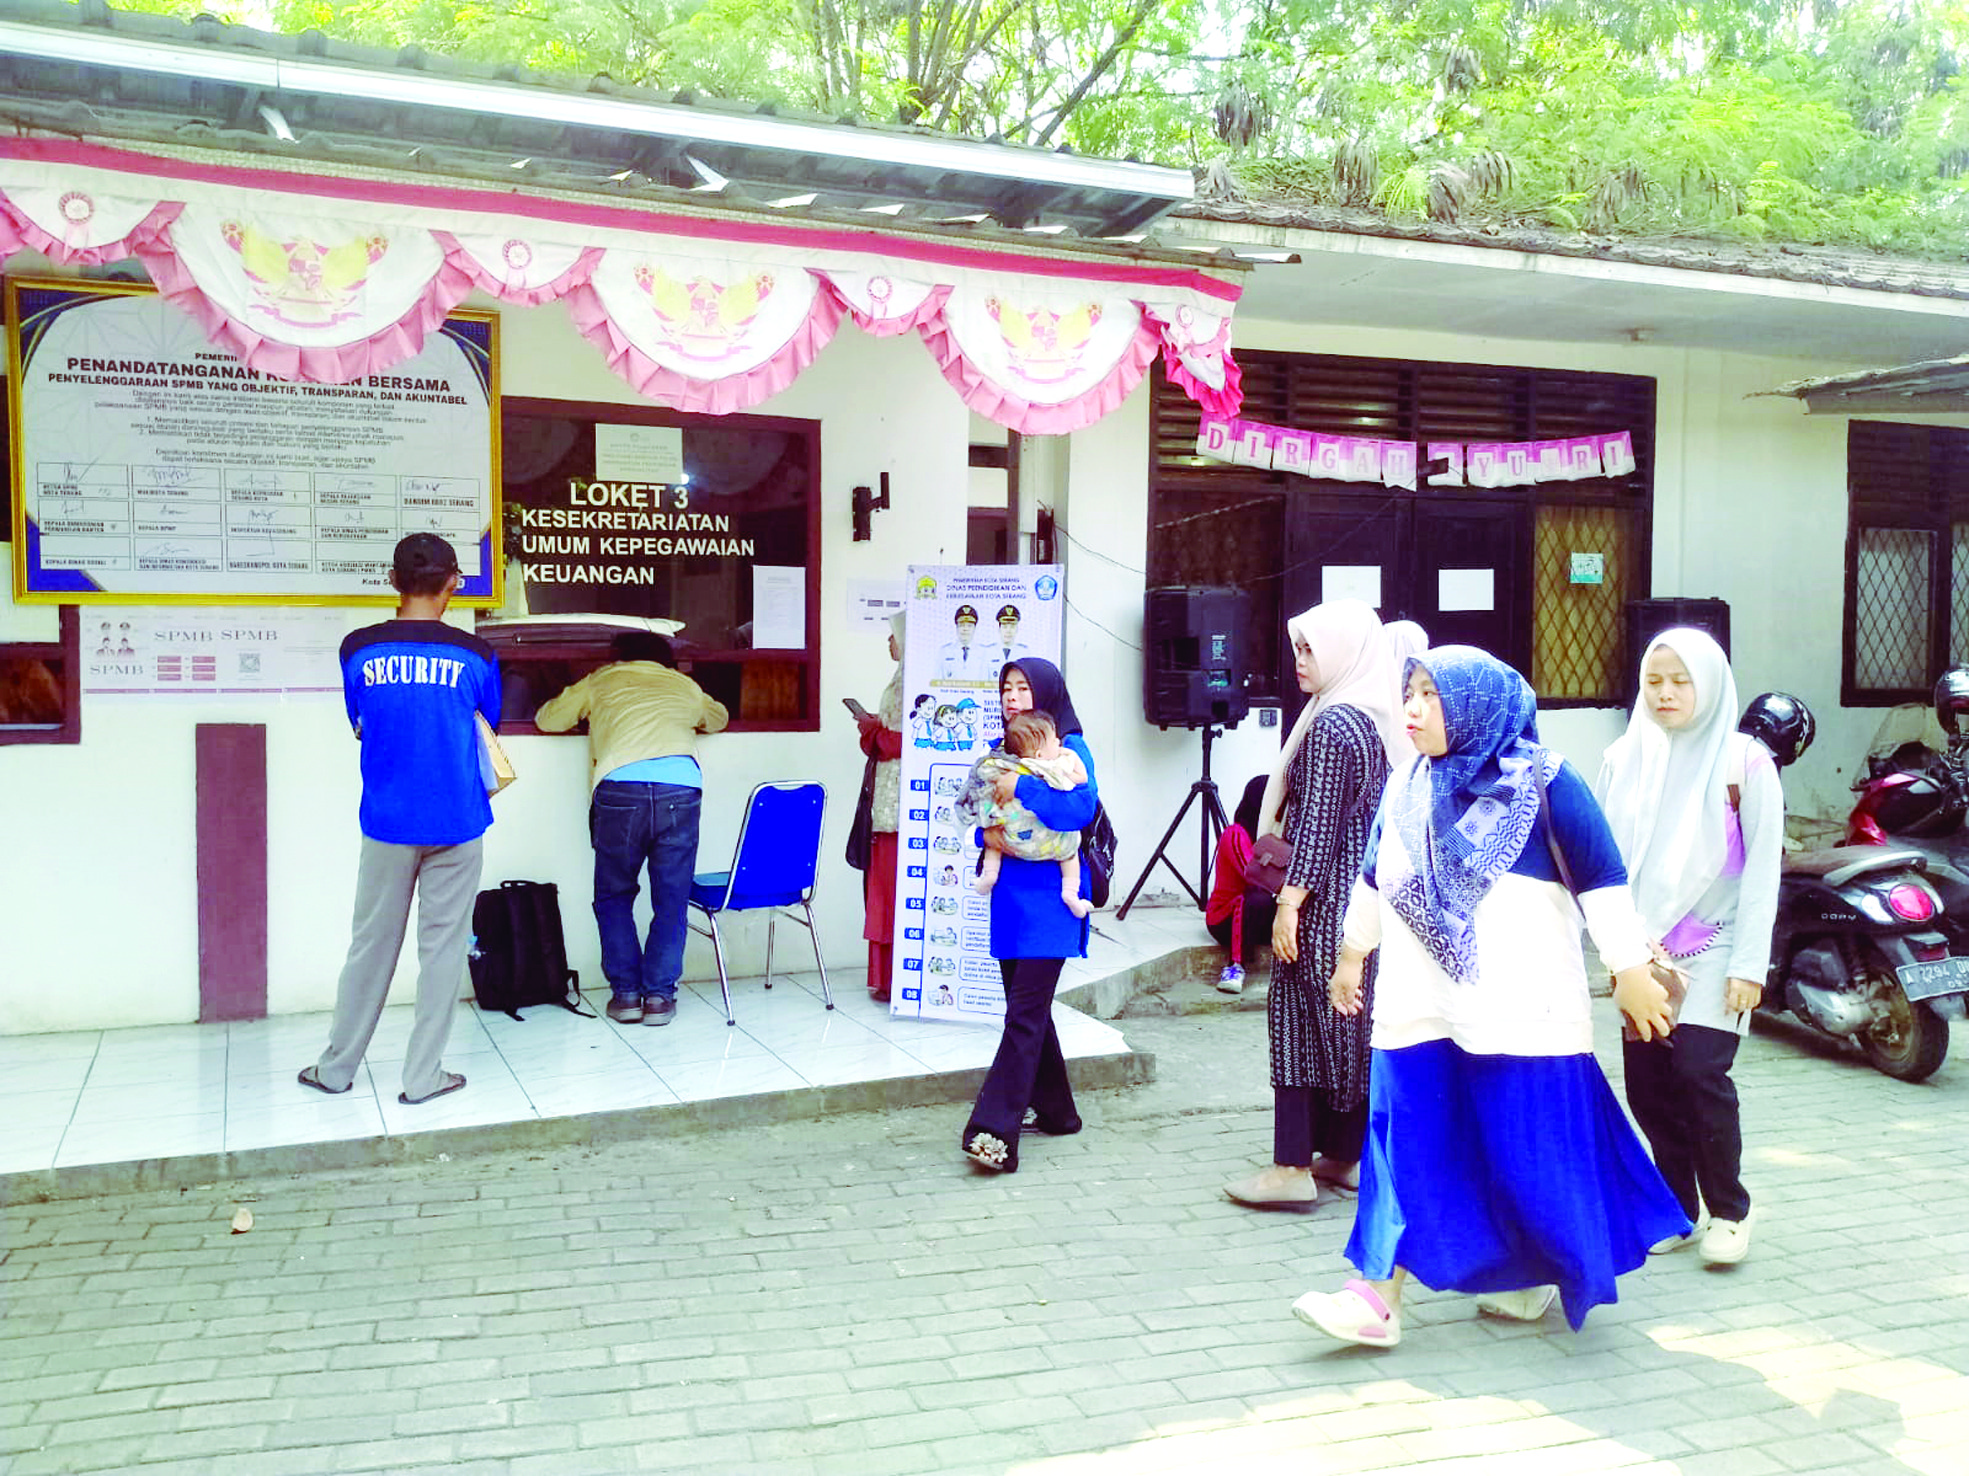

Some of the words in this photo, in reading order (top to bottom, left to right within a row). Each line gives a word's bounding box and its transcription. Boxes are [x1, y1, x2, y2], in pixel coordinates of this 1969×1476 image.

[195, 352, 238, 362] PEMERI
[67, 357, 259, 380] PENANDATANGANAN
[369, 375, 450, 392] BERSAMA
[49, 373, 168, 388] PENYELENGGARAAN
[172, 379, 203, 390] SPMB
[208, 381, 238, 392] YANG
[242, 383, 298, 396] OBJEKTIF,
[302, 387, 377, 400] TRANSPARAN,
[381, 391, 401, 401] DAN
[406, 393, 467, 406] AKUNTABEL
[570, 482, 666, 508] LOKET
[674, 486, 689, 509] 3
[522, 509, 729, 532] KESEKRETARIATAN
[522, 535, 590, 555] UMUM
[600, 537, 754, 556] KEPEGAWAIAN
[523, 564, 654, 585] KEUANGAN
[155, 631, 213, 642] SPMB
[221, 630, 278, 641] SPMB
[90, 665, 143, 676] SPMB
[363, 656, 465, 688] SECURITY
[915, 782, 926, 790] 01
[914, 811, 925, 819] 02
[913, 839, 924, 847] 03
[911, 868, 922, 876] 04
[910, 899, 921, 907] 05
[907, 960, 919, 968] 07
